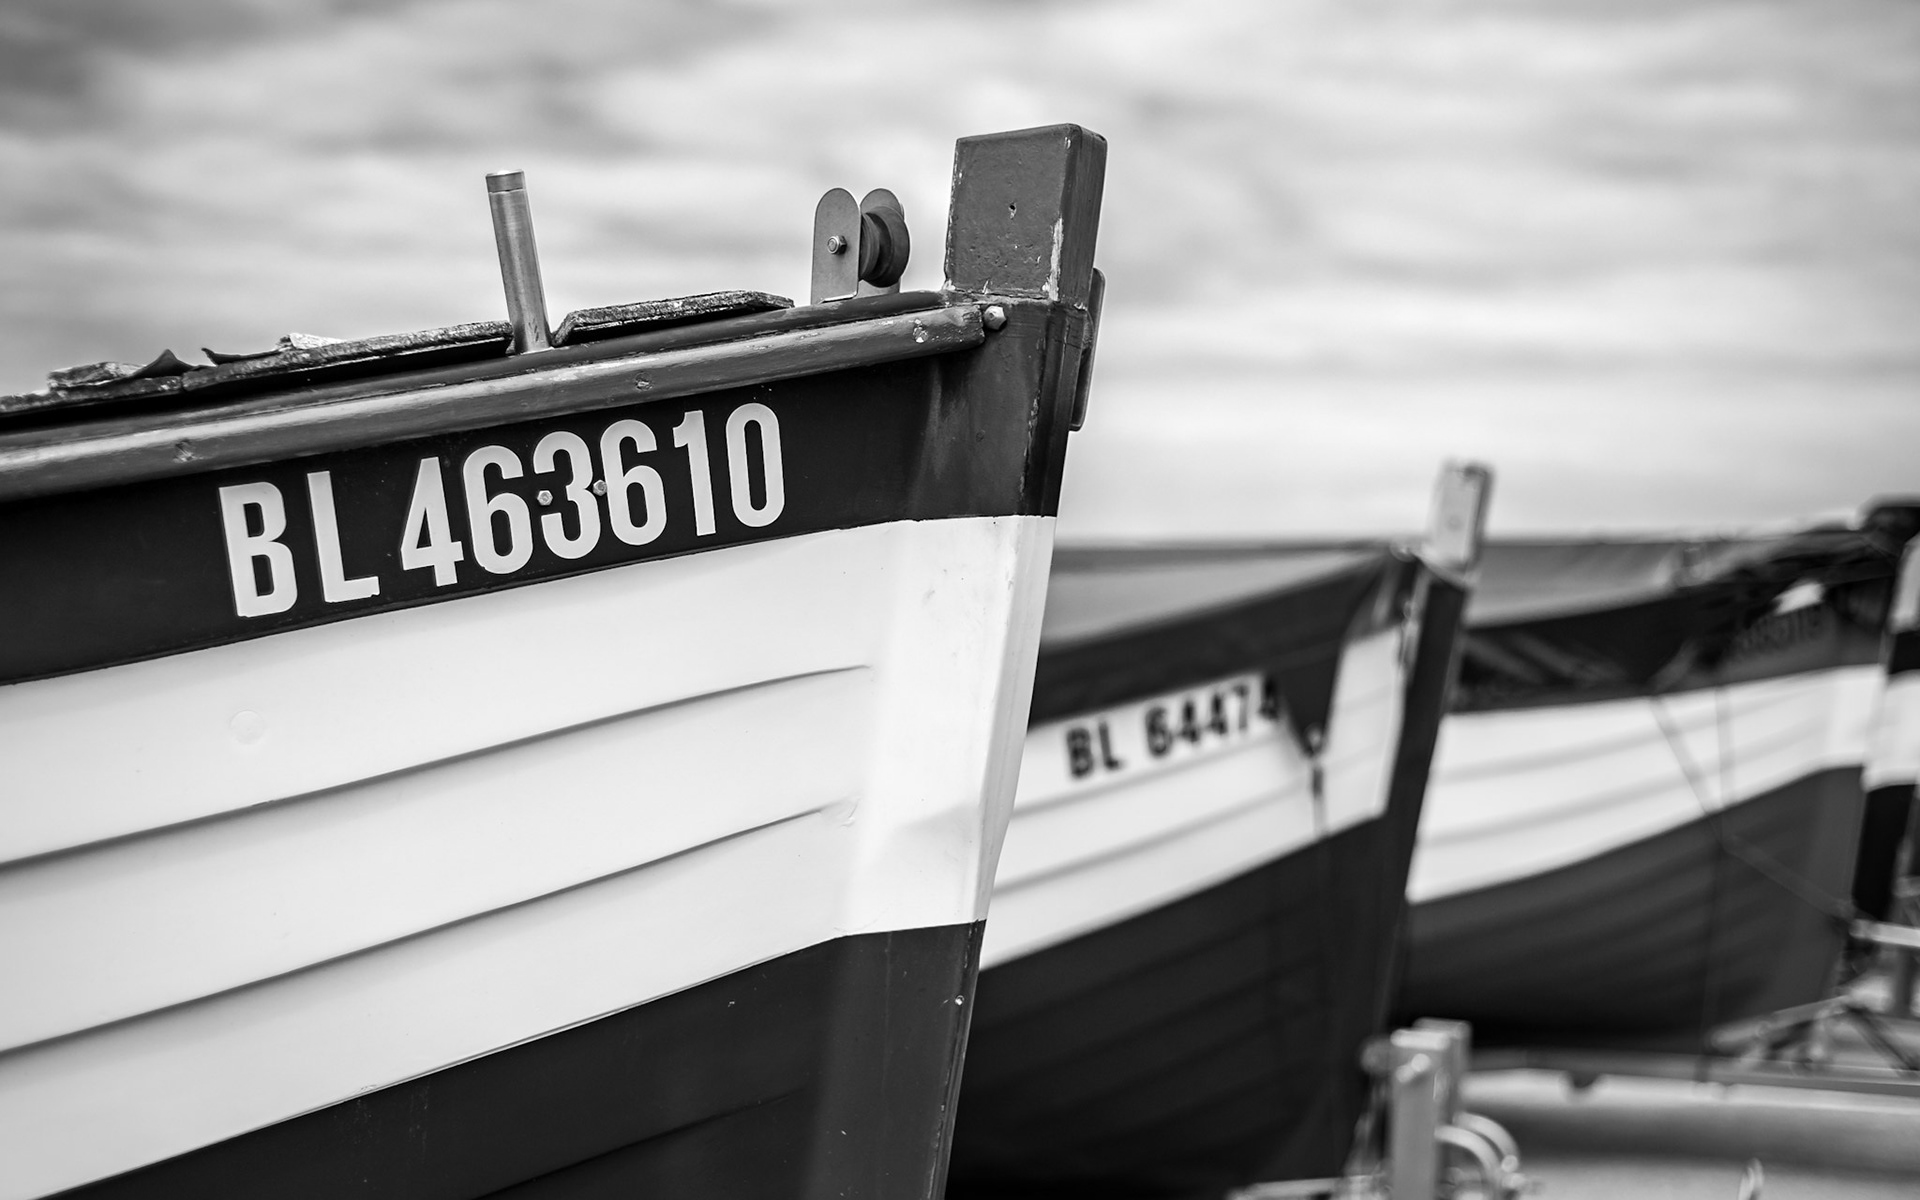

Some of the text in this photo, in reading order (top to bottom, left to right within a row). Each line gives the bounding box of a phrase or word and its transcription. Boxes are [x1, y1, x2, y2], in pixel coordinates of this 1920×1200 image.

[218, 402, 785, 617] BL 463610
[1067, 719, 1123, 778] BL
